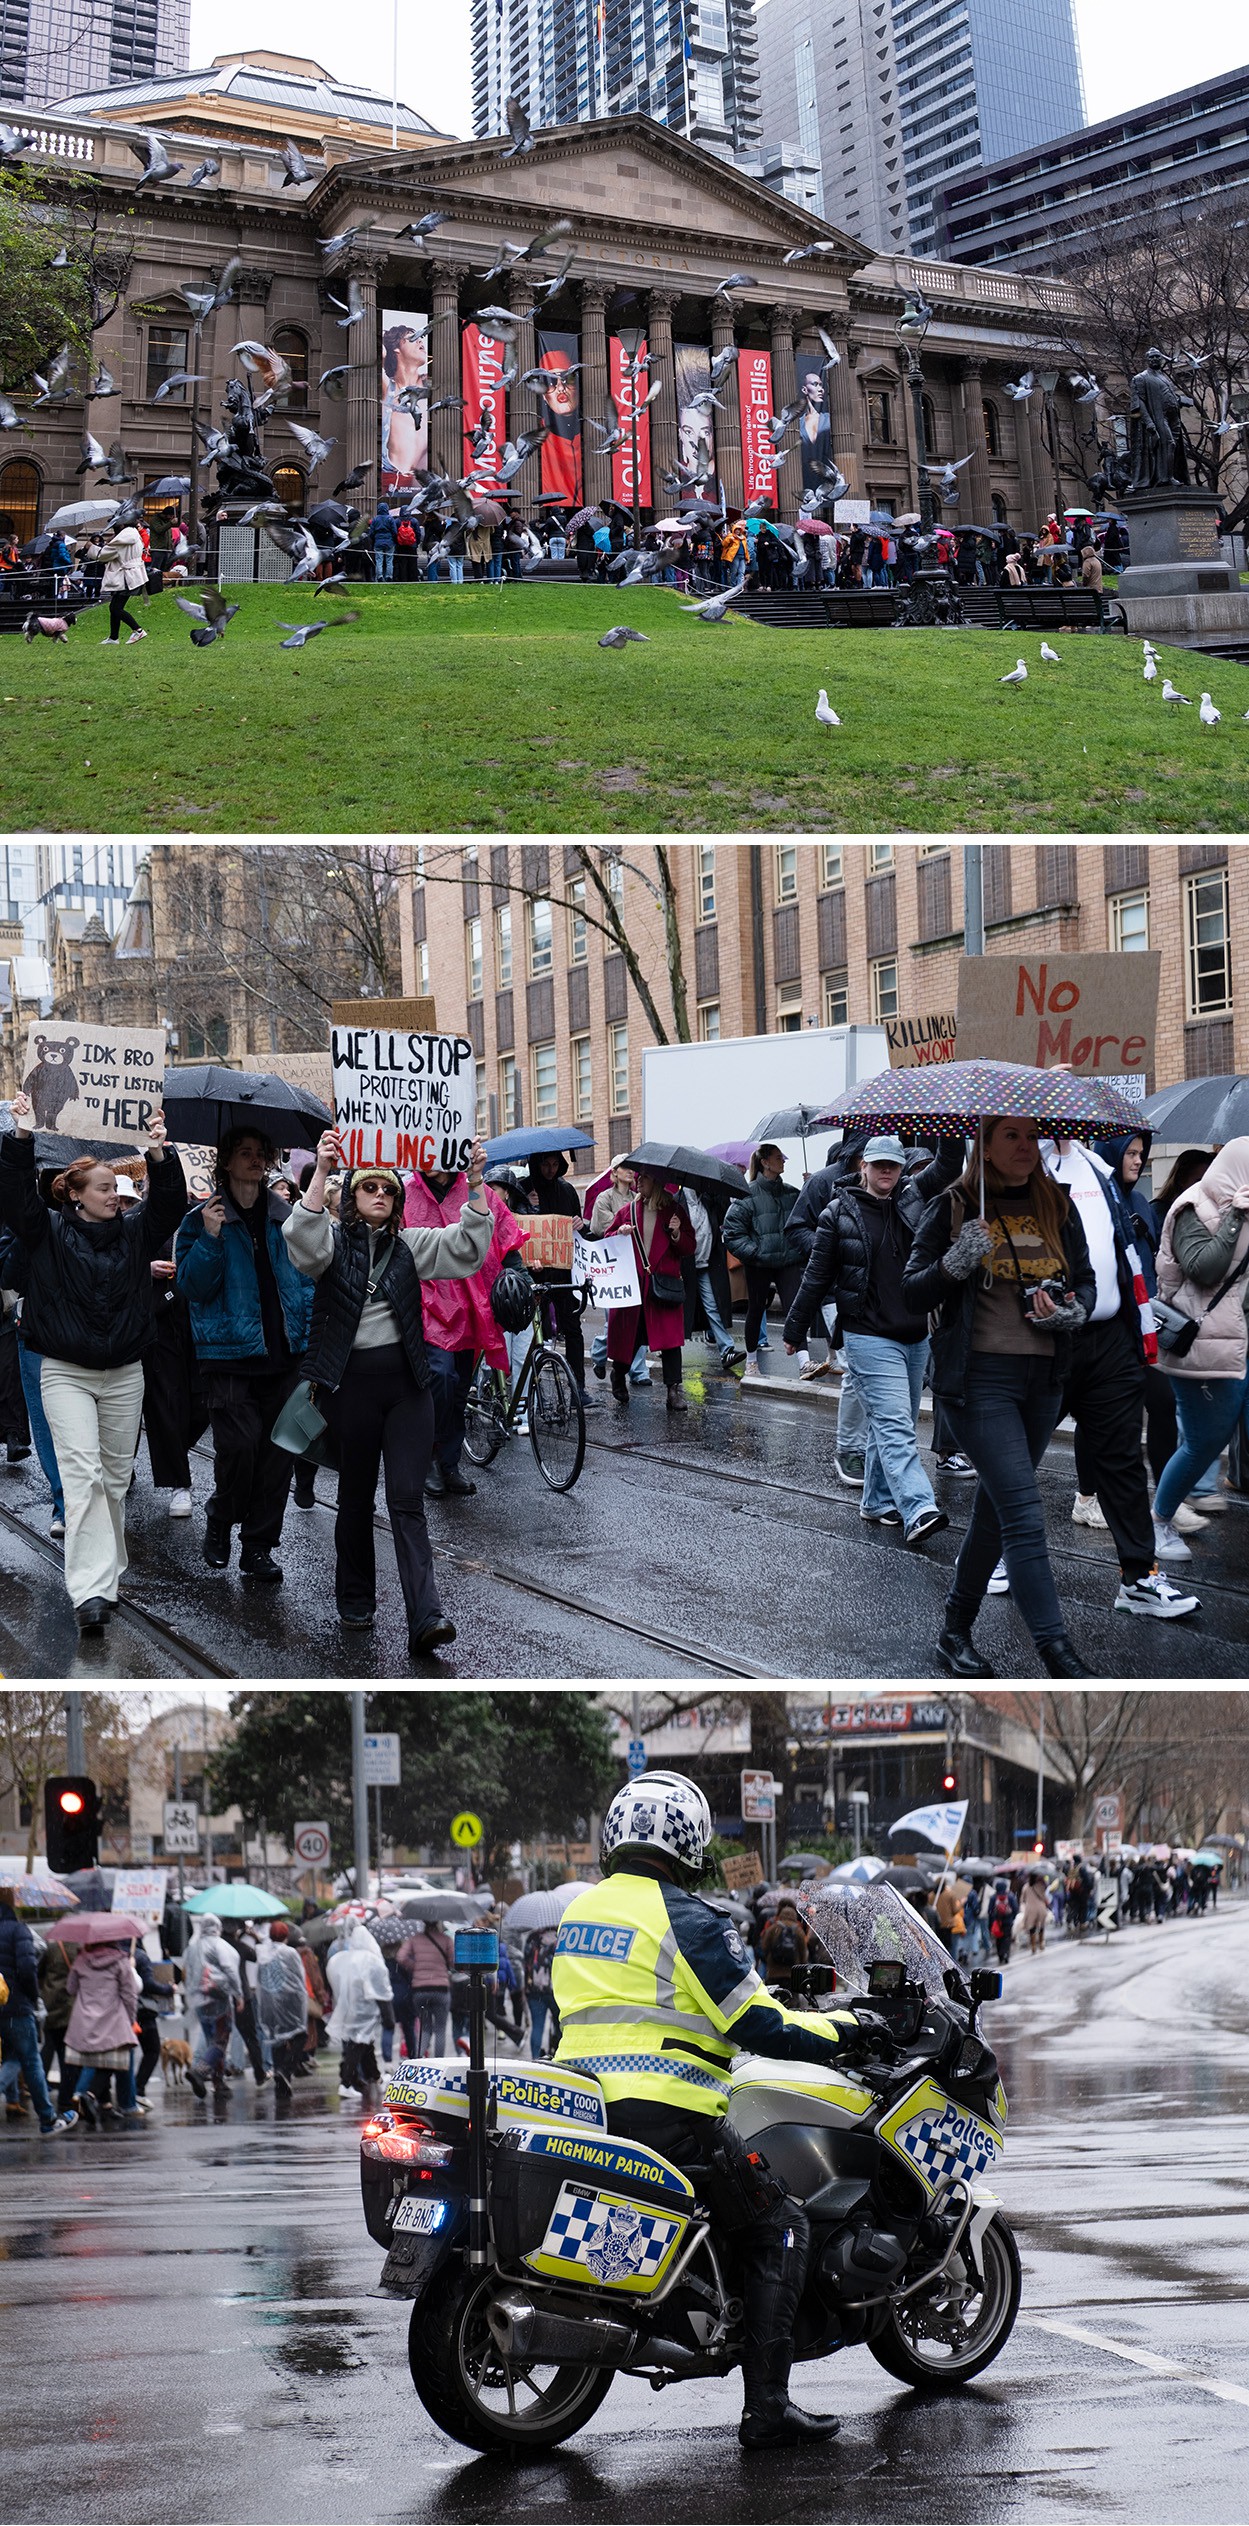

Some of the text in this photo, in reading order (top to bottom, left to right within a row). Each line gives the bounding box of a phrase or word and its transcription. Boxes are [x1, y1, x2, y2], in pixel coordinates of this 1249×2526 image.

[474, 333, 497, 482] Mebourne
[750, 358, 773, 490] Rennie Ellis
[746, 444, 754, 474] through
[1015, 963, 1080, 1016] No
[82, 1043, 154, 1066] IDK BRO
[332, 1029, 472, 1077] WE'LL STOP
[913, 1039, 955, 1063] WONT
[1035, 1018, 1147, 1068] More
[79, 1072, 164, 1093] JUST LISTEN
[282, 1068, 331, 1079] DAUGHTE
[360, 1074, 450, 1109] PROTESTING
[84, 1097, 153, 1131] TO HER
[334, 1097, 386, 1124] WHEN
[391, 1104, 422, 1130] YOU
[425, 1106, 462, 1134] STOP
[332, 1126, 473, 1172] KILLING US
[190, 1174, 215, 1193] CY
[521, 1241, 574, 1266] ILENT
[574, 1238, 617, 1263] REAL
[578, 1280, 632, 1299] OMEN
[1101, 1805, 1115, 1817] 40
[167, 1834, 195, 1847] LANE
[302, 1837, 323, 1852] 40
[556, 1926, 630, 1956] POLICE
[384, 2083, 427, 2107] Police
[501, 2080, 562, 2110] Police
[938, 2103, 995, 2158] Police
[545, 2137, 665, 2185] HIGHWAY PATROL
[572, 2186, 592, 2198] BMW
